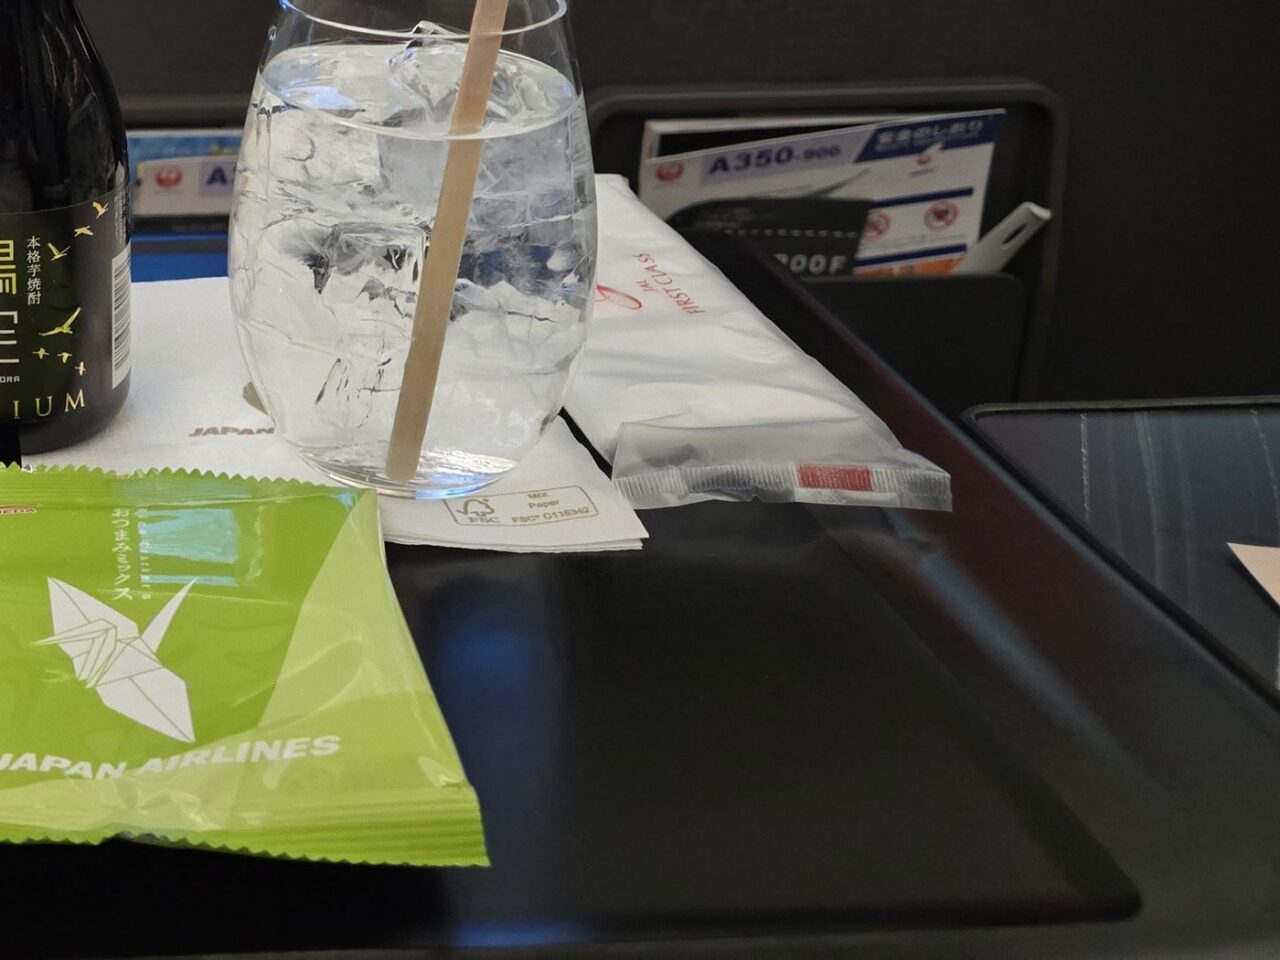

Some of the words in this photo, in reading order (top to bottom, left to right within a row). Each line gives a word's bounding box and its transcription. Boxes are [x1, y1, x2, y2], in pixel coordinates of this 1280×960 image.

[27, 235, 42, 306] 本格芋焼酎
[633, 253, 673, 285] CLASS
[663, 287, 706, 314] FIRST
[188, 426, 275, 437] JAPAN
[528, 500, 560, 509] Paper
[112, 508, 134, 601] おつまみミックス
[133, 734, 341, 776] AIRLINES
